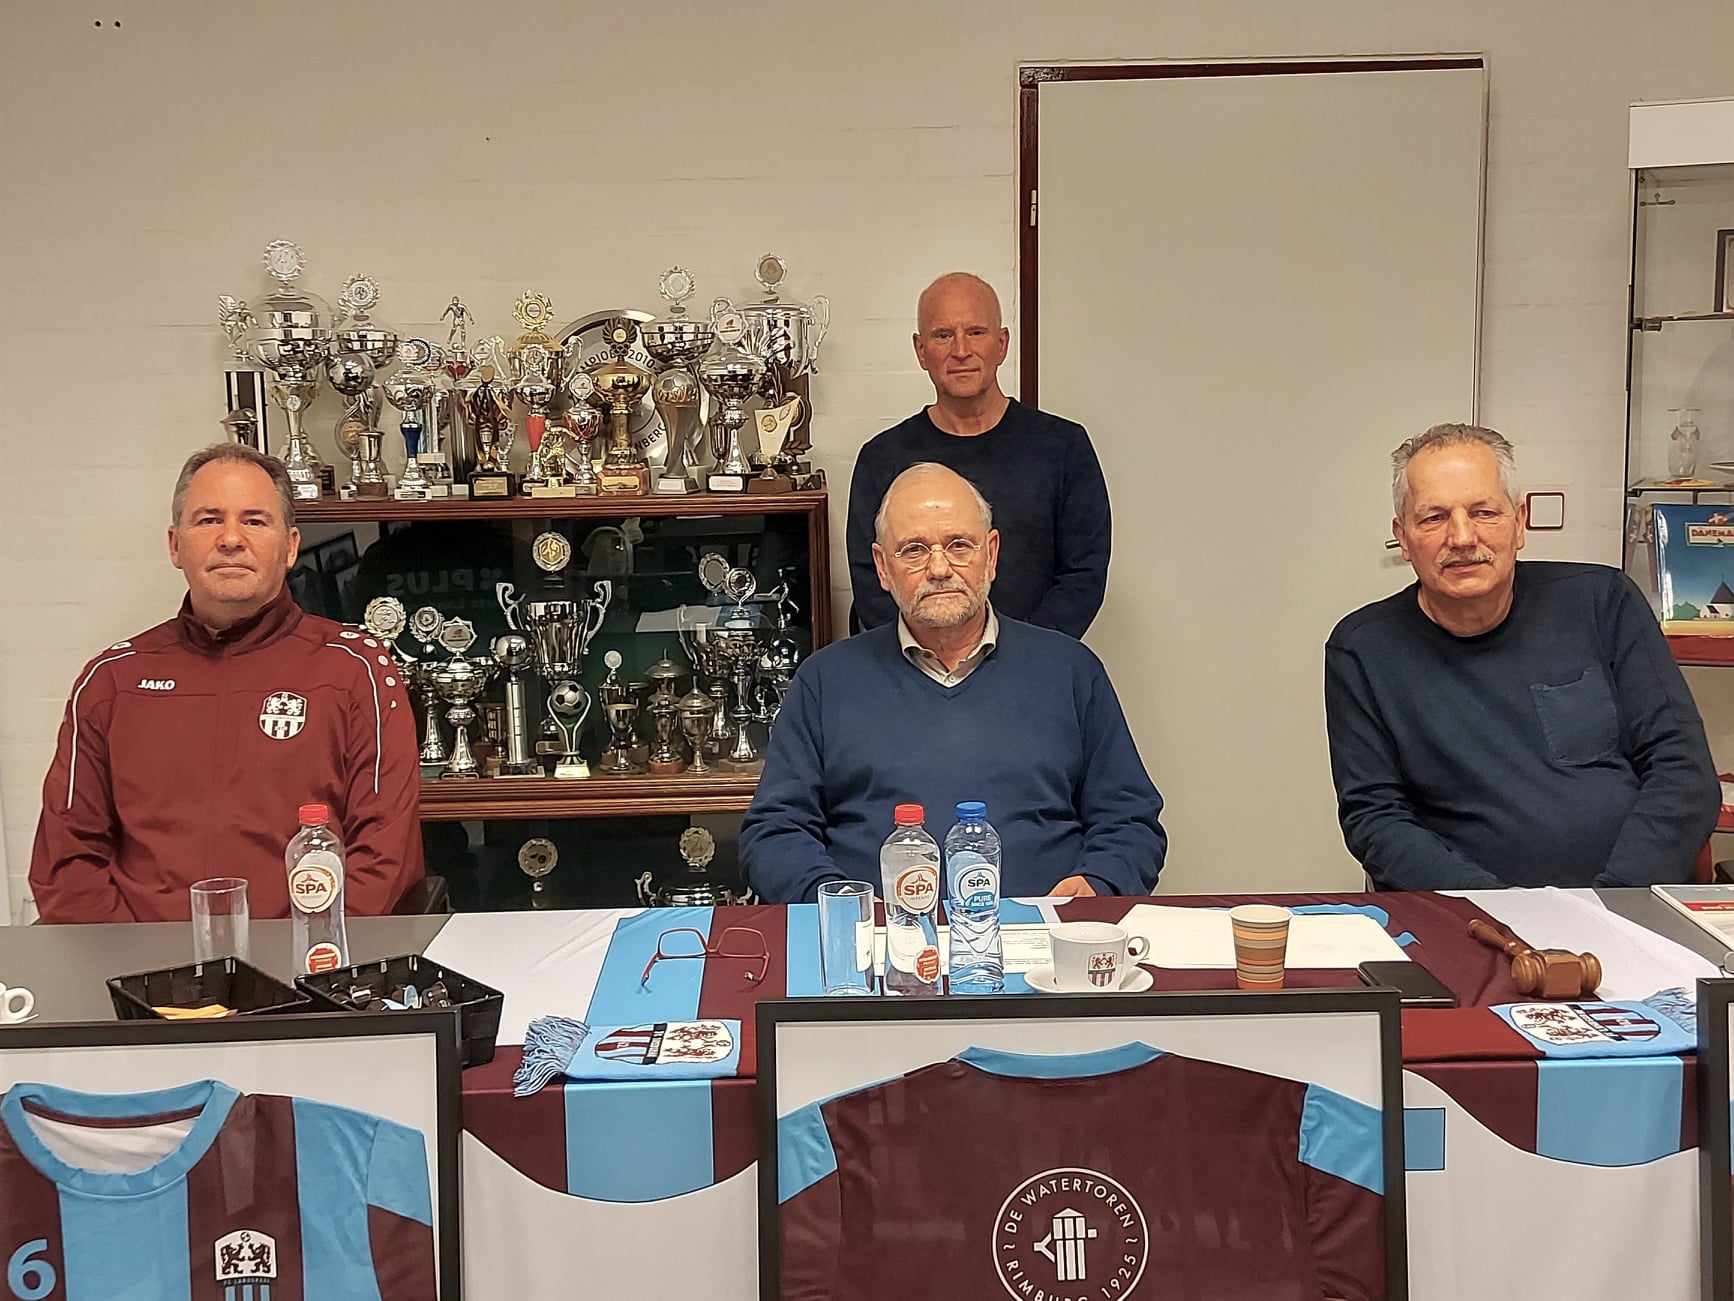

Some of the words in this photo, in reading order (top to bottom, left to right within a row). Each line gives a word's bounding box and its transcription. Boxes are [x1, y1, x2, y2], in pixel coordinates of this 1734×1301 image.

[137, 679, 176, 691] JAKO
[295, 882, 327, 894] SPA
[903, 882, 934, 895] SPA
[967, 878, 991, 887] SPA
[1004, 1209, 1023, 1234] DE
[1020, 1178, 1135, 1229] WATERTOREN
[7, 1238, 56, 1300] 6
[1101, 1254, 1137, 1299] 1925
